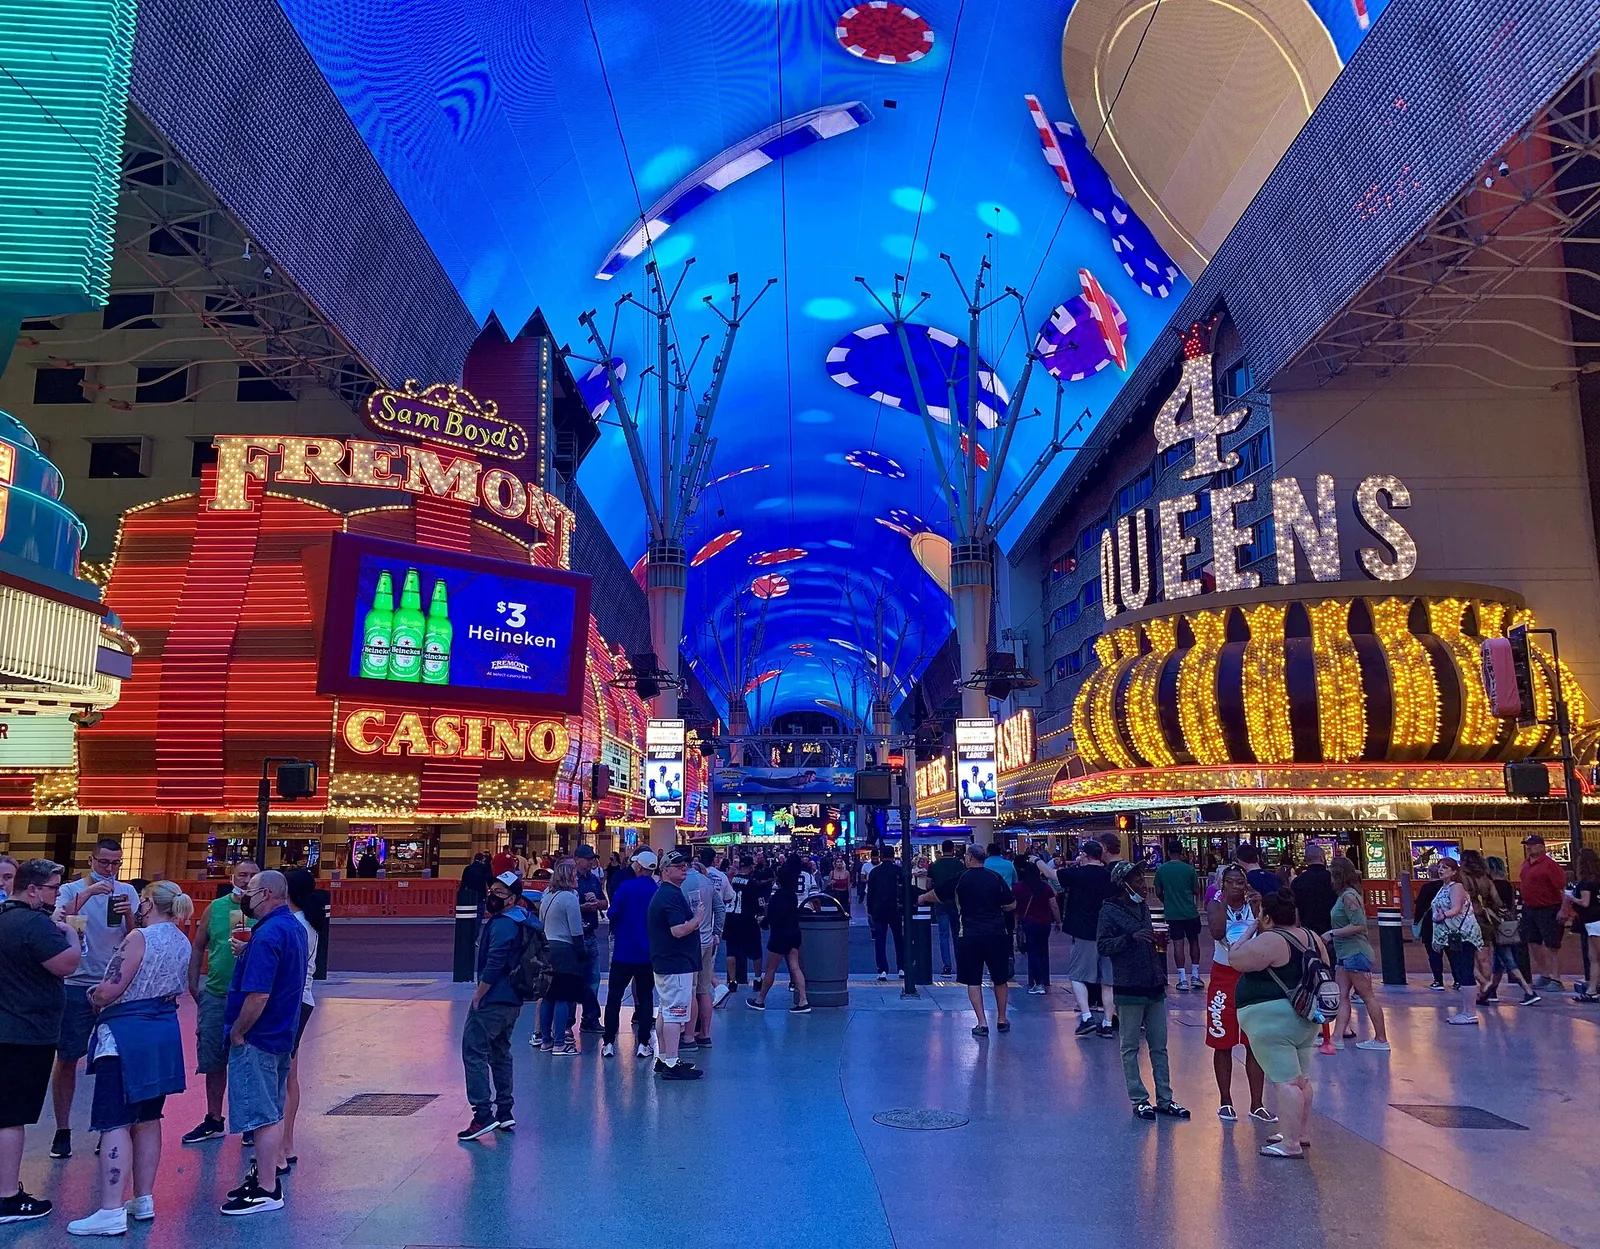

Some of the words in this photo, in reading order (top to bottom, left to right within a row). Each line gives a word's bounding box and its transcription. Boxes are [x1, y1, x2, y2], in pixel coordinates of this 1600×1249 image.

[379, 395, 440, 432] Sam
[443, 411, 519, 451] Boyd's
[1154, 353, 1249, 480] 4
[206, 434, 576, 569] FREMONT
[1100, 474, 1417, 621] QUEENS
[496, 601, 527, 628] $3
[468, 624, 556, 648] Heineken
[391, 646, 421, 655] Heineken
[424, 653, 449, 661] eineken
[490, 660, 529, 674] FREMONT
[343, 708, 569, 763] CASINO
[997, 709, 1032, 774] ASINO
[655, 751, 676, 759] LADIES
[966, 751, 988, 759] LADIES
[649, 798, 680, 807] Downtown
[963, 799, 995, 808] Downtown
[709, 835, 731, 845] CIGARS
[1368, 846, 1383, 858] $5
[1208, 990, 1227, 1038] Cookies
